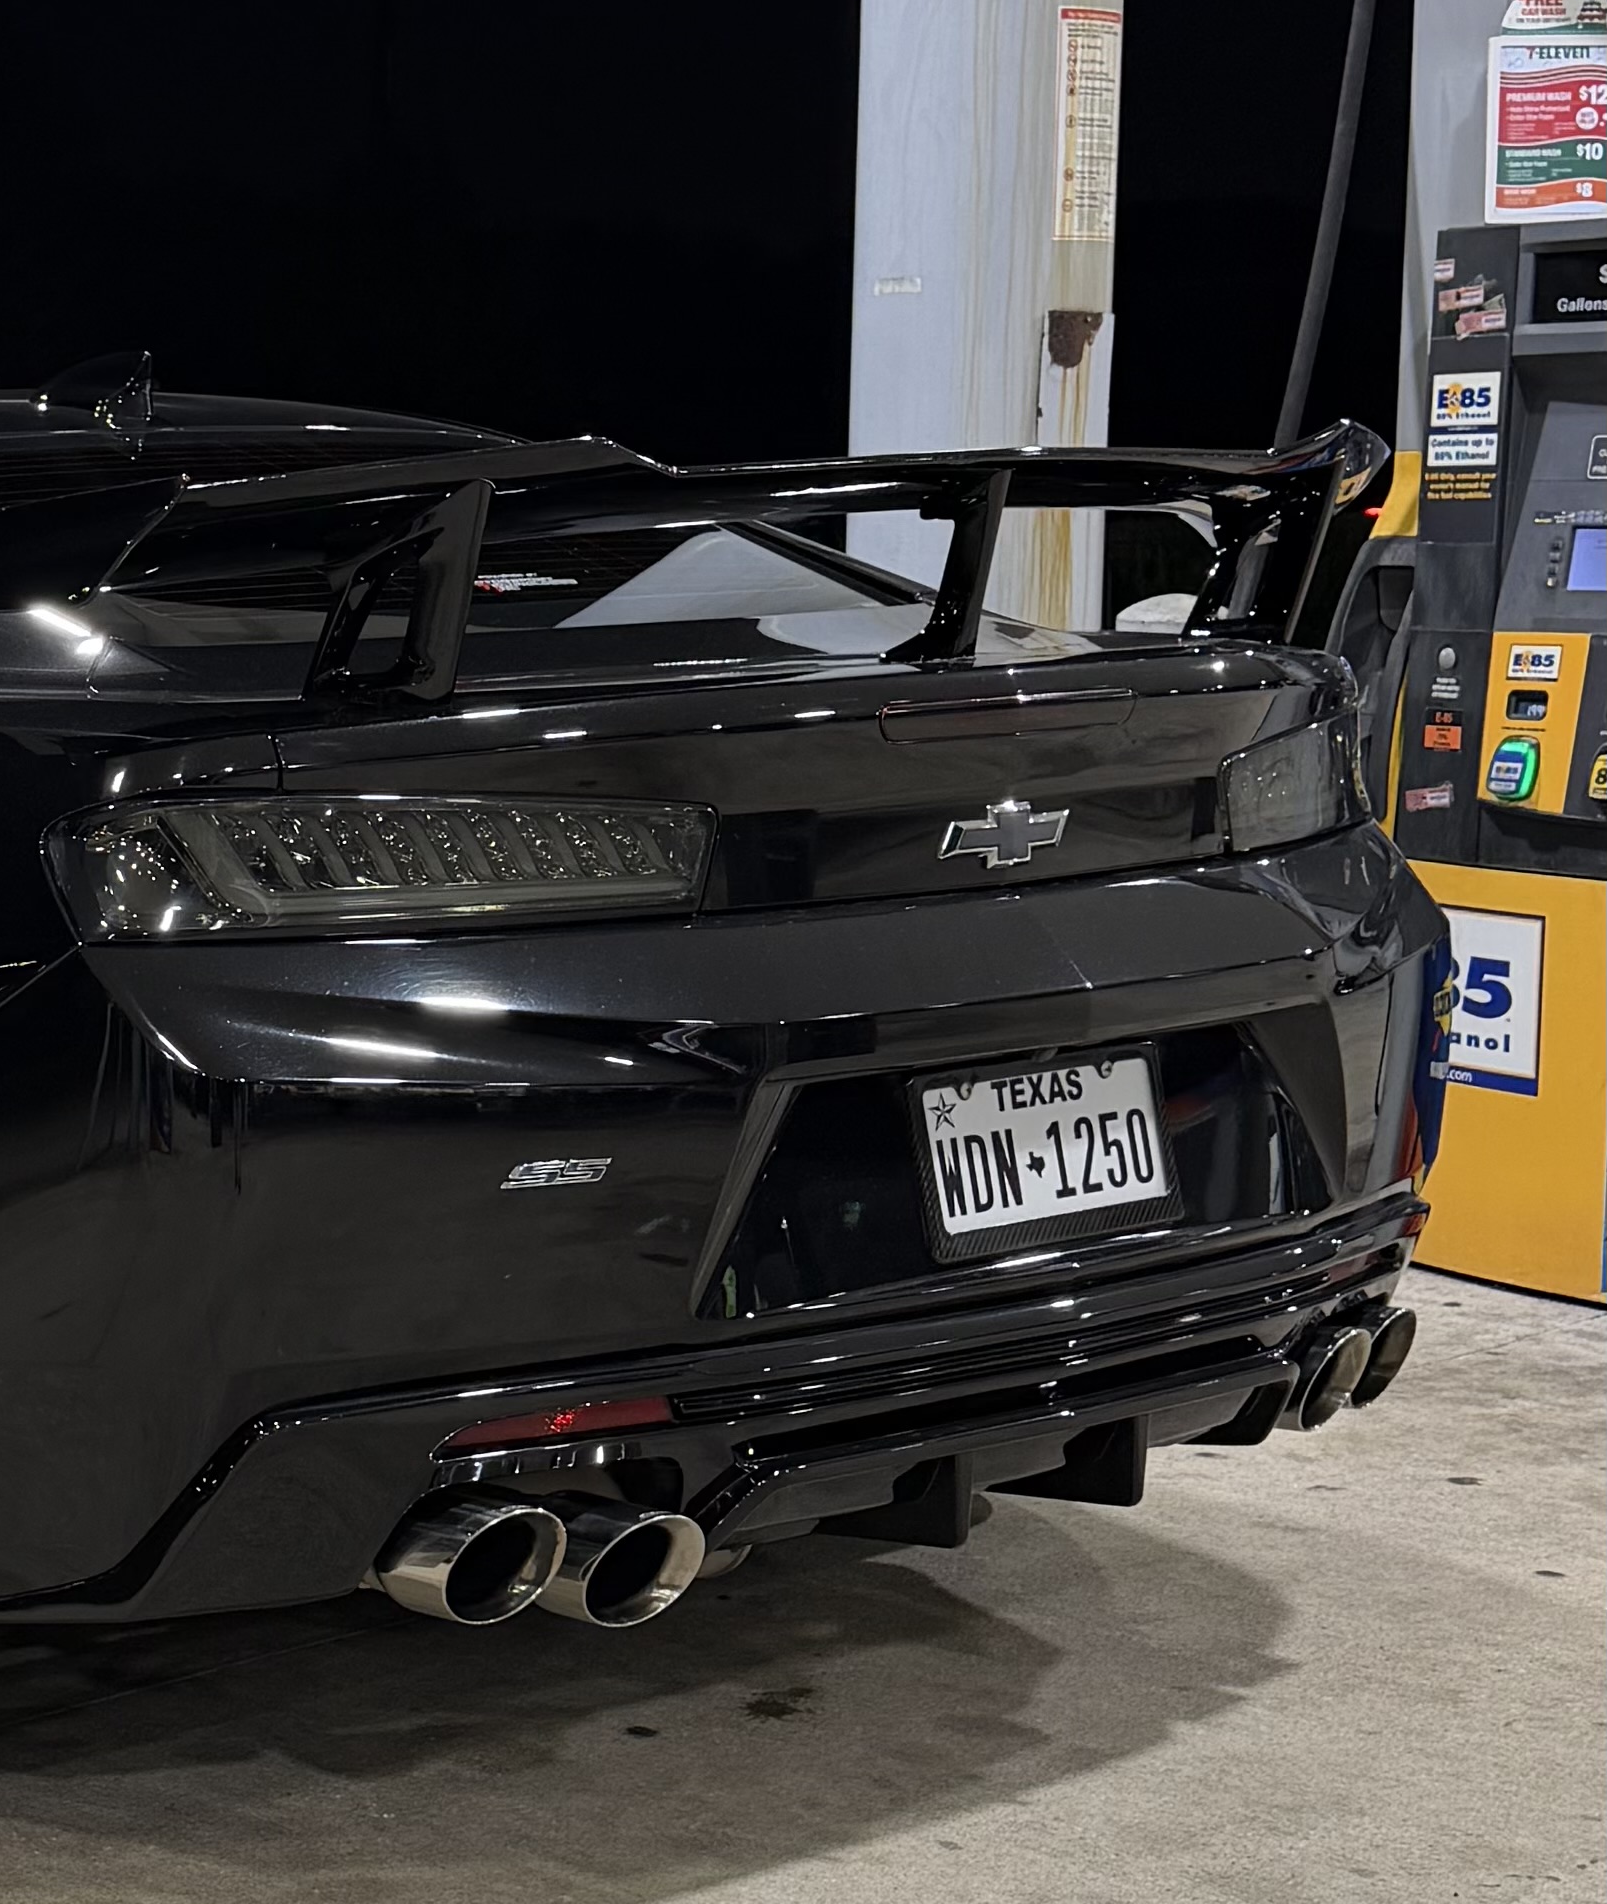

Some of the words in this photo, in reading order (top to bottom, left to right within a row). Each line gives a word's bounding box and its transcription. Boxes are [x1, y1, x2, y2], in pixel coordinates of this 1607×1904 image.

[1576, 142, 1603, 160] $10
[1576, 182, 1593, 197] $8
[990, 1068, 1084, 1112] TEXAS
[500, 1157, 613, 1189] SS
[936, 1128, 1024, 1218] WDN
[1046, 1108, 1155, 1200] 1250
